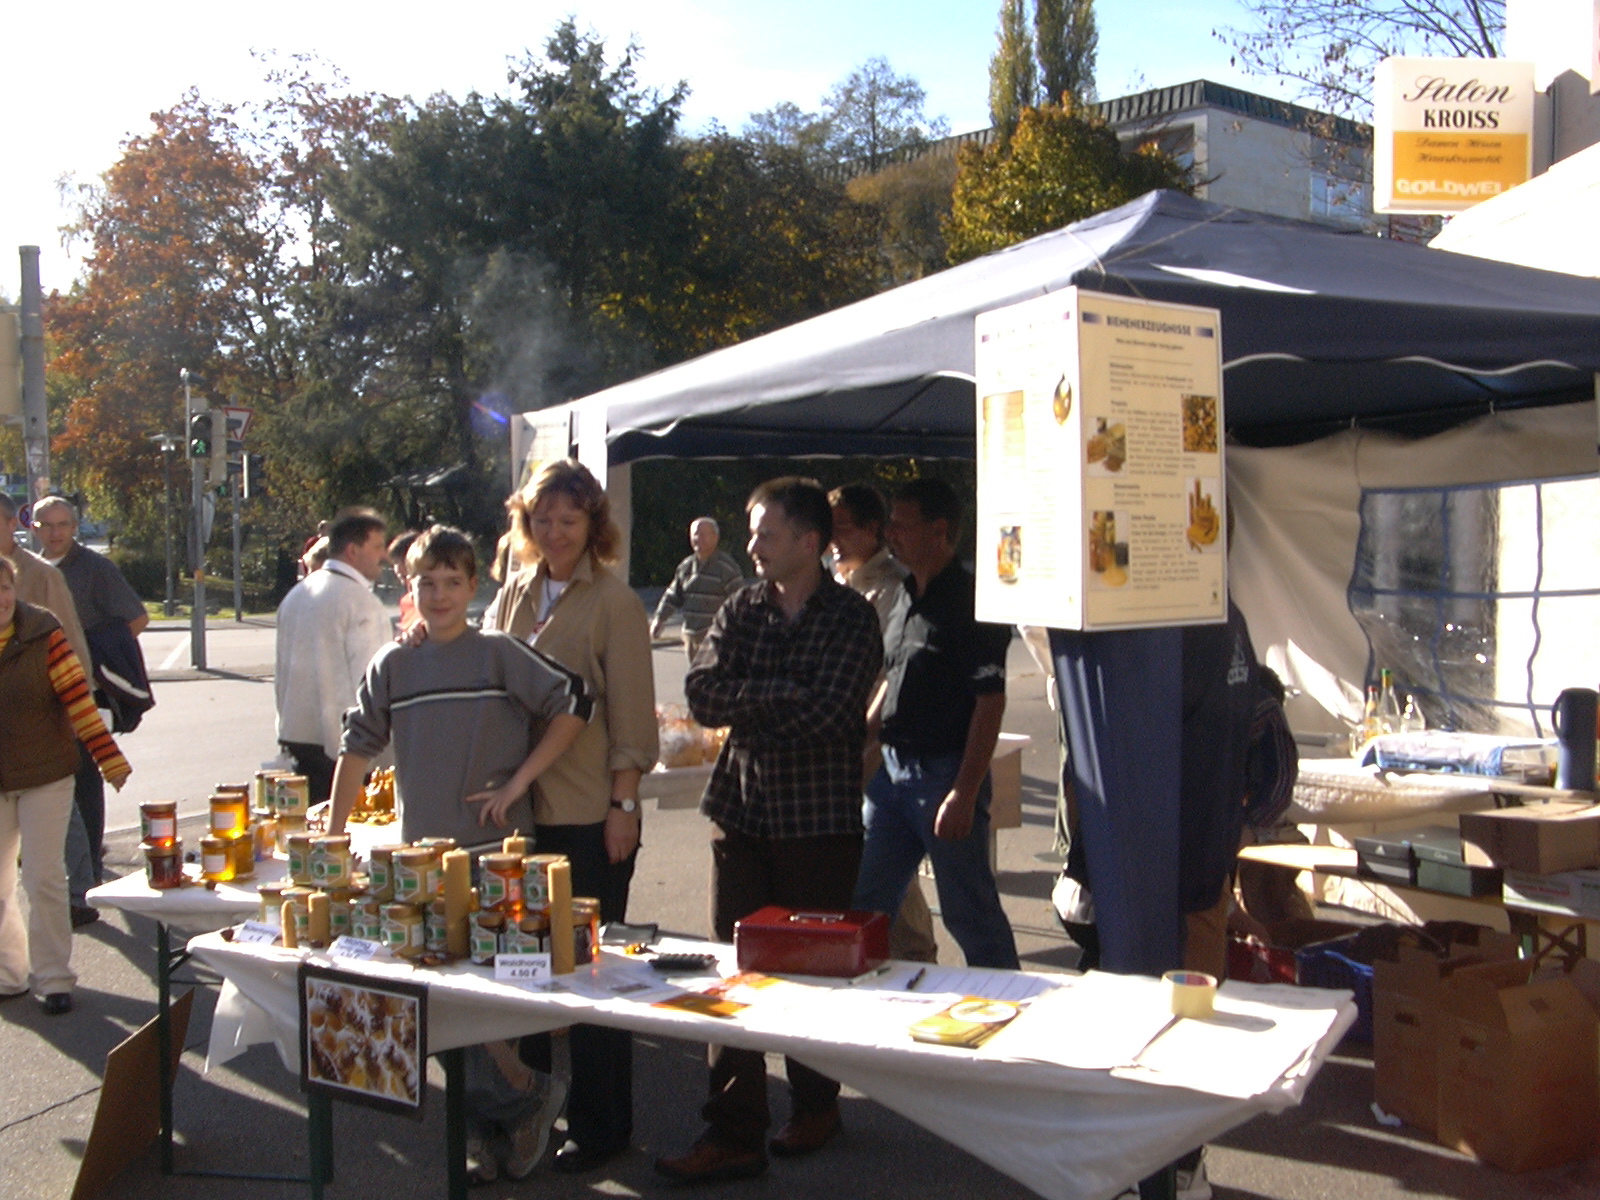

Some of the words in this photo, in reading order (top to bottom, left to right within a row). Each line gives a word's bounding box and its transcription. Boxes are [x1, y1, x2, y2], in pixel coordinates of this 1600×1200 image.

[1403, 75, 1515, 103] Salon
[1424, 109, 1499, 129] KROISS
[1396, 178, 1517, 197] GOLDWEL
